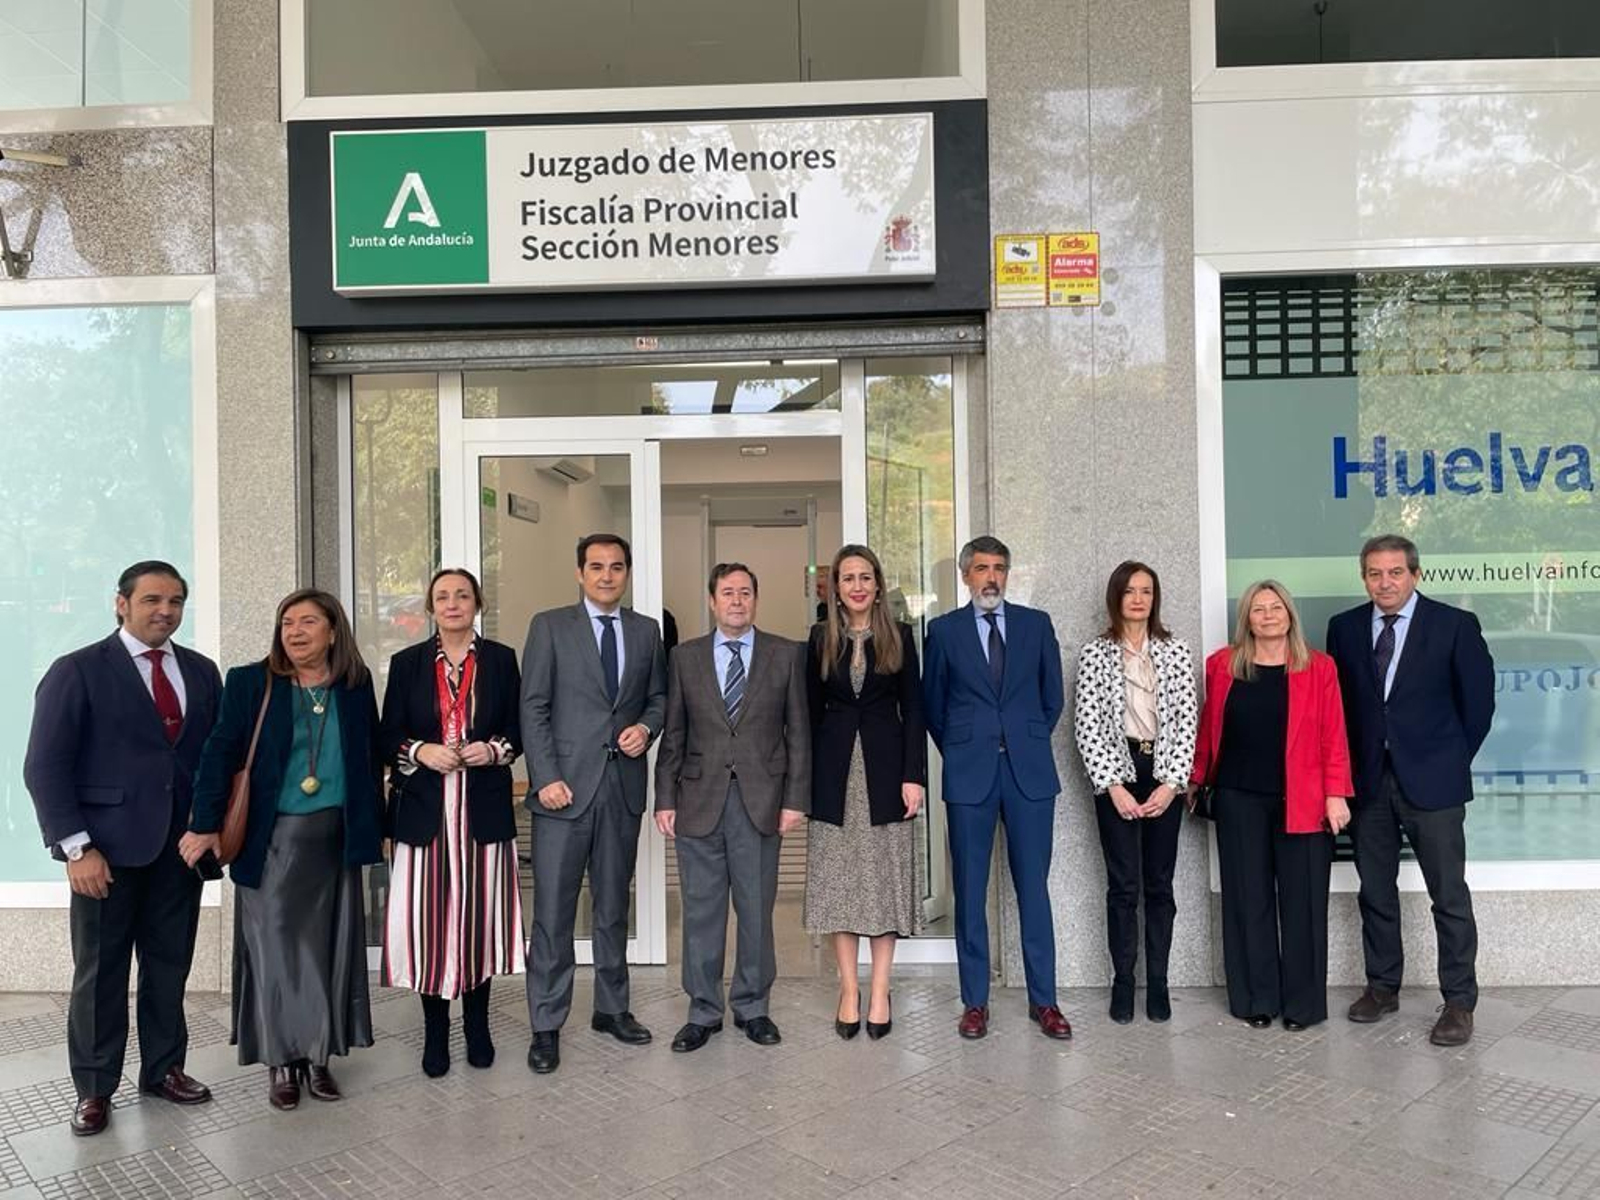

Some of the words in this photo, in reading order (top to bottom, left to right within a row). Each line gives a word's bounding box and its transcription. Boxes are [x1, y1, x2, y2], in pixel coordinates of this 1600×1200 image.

[520, 148, 650, 183] Juzgado
[658, 147, 696, 174] de
[705, 147, 837, 172] Menores
[520, 194, 635, 226] Fiscalía
[644, 192, 799, 223] Provincial
[349, 236, 386, 248] Junta
[388, 234, 406, 247] de
[408, 232, 475, 246] Andalucía
[521, 229, 639, 261] Sección
[649, 232, 780, 258] Menores
[1054, 257, 1095, 267] Alarma
[1333, 432, 1595, 499] Huelva
